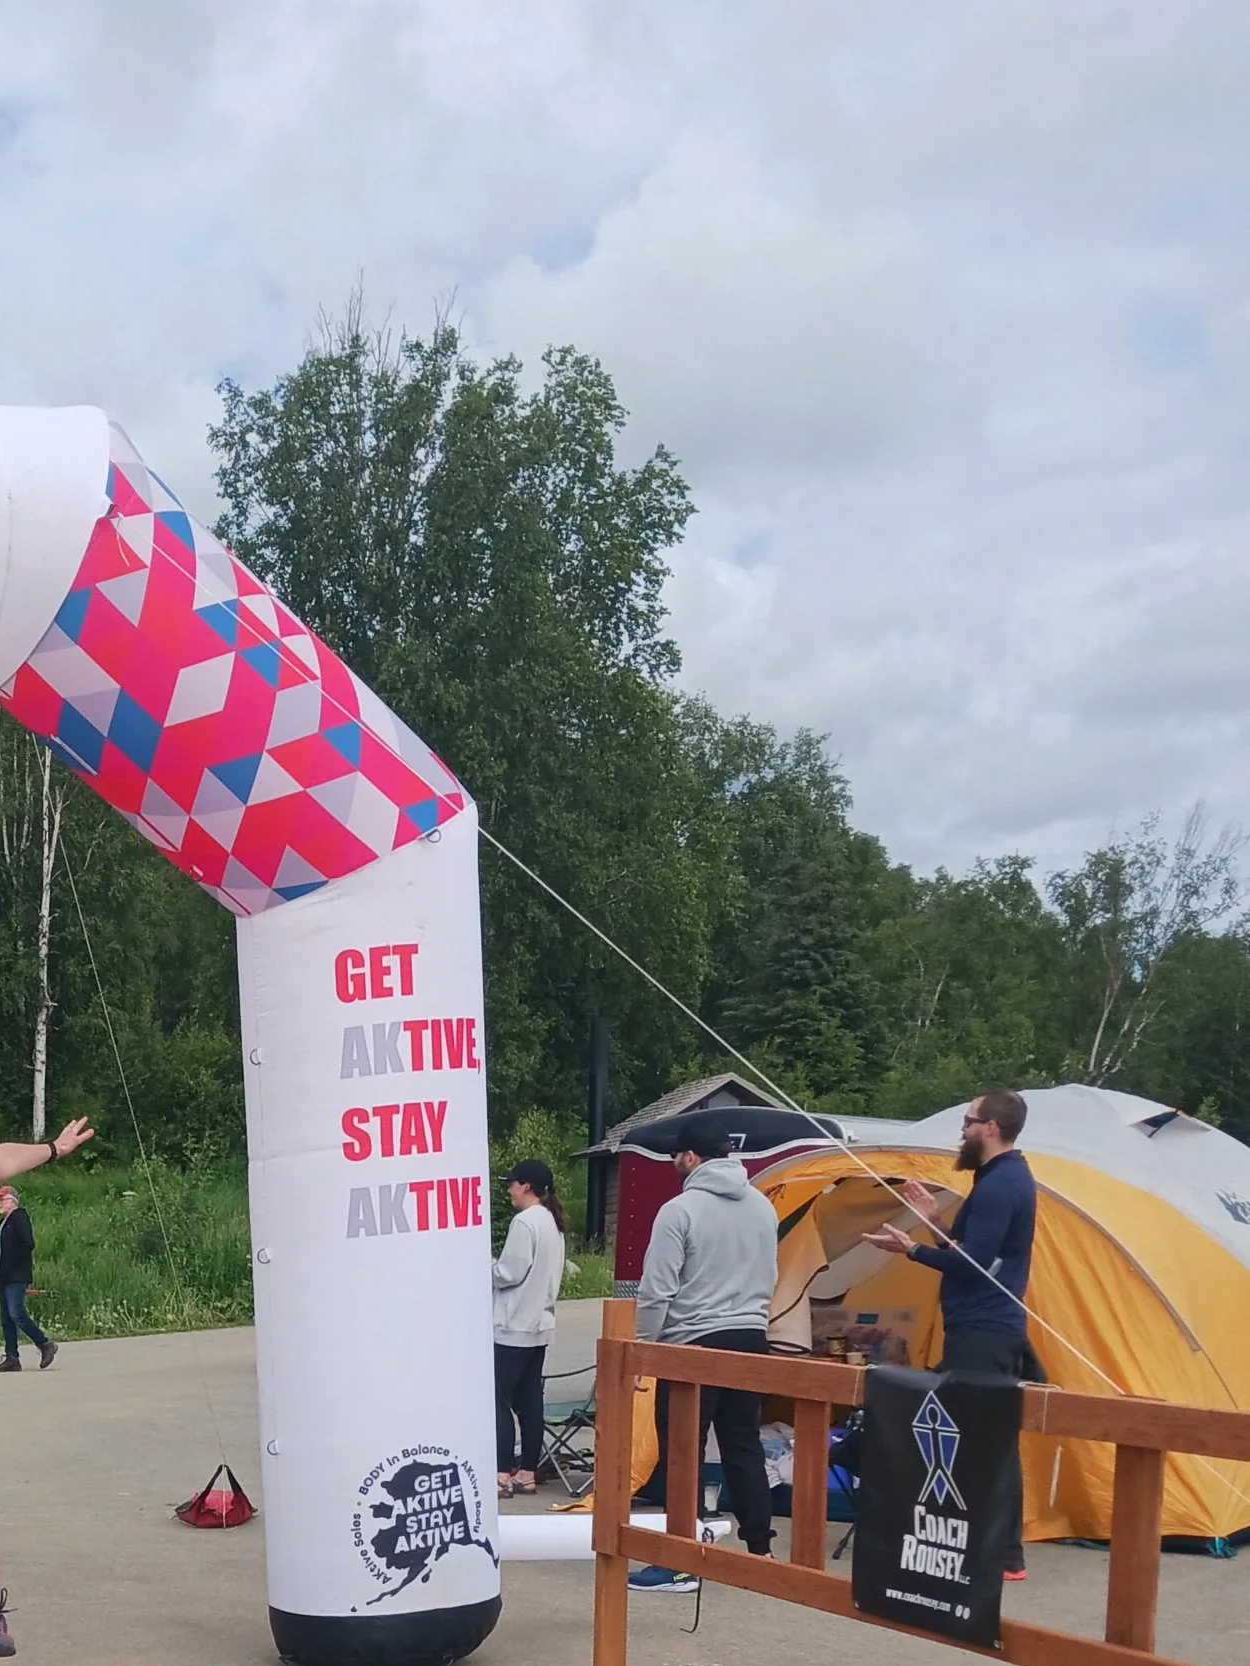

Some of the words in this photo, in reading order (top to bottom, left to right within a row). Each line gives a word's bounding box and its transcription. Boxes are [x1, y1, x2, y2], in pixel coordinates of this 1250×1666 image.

[334, 943, 419, 1004] GET
[341, 1100, 449, 1162] STAY
[346, 1175, 483, 1239] AKTIVE
[358, 1462, 386, 1496] BODY
[386, 1455, 400, 1467] In
[401, 1444, 451, 1459] Balance
[413, 1468, 454, 1493] GET
[391, 1484, 463, 1517] AKTIVE
[405, 1506, 455, 1533] STAY
[350, 1513, 364, 1547] Soles
[394, 1520, 465, 1554] AKTIVE
[913, 1504, 969, 1550] COACH
[900, 1533, 965, 1583] ROUSEY
